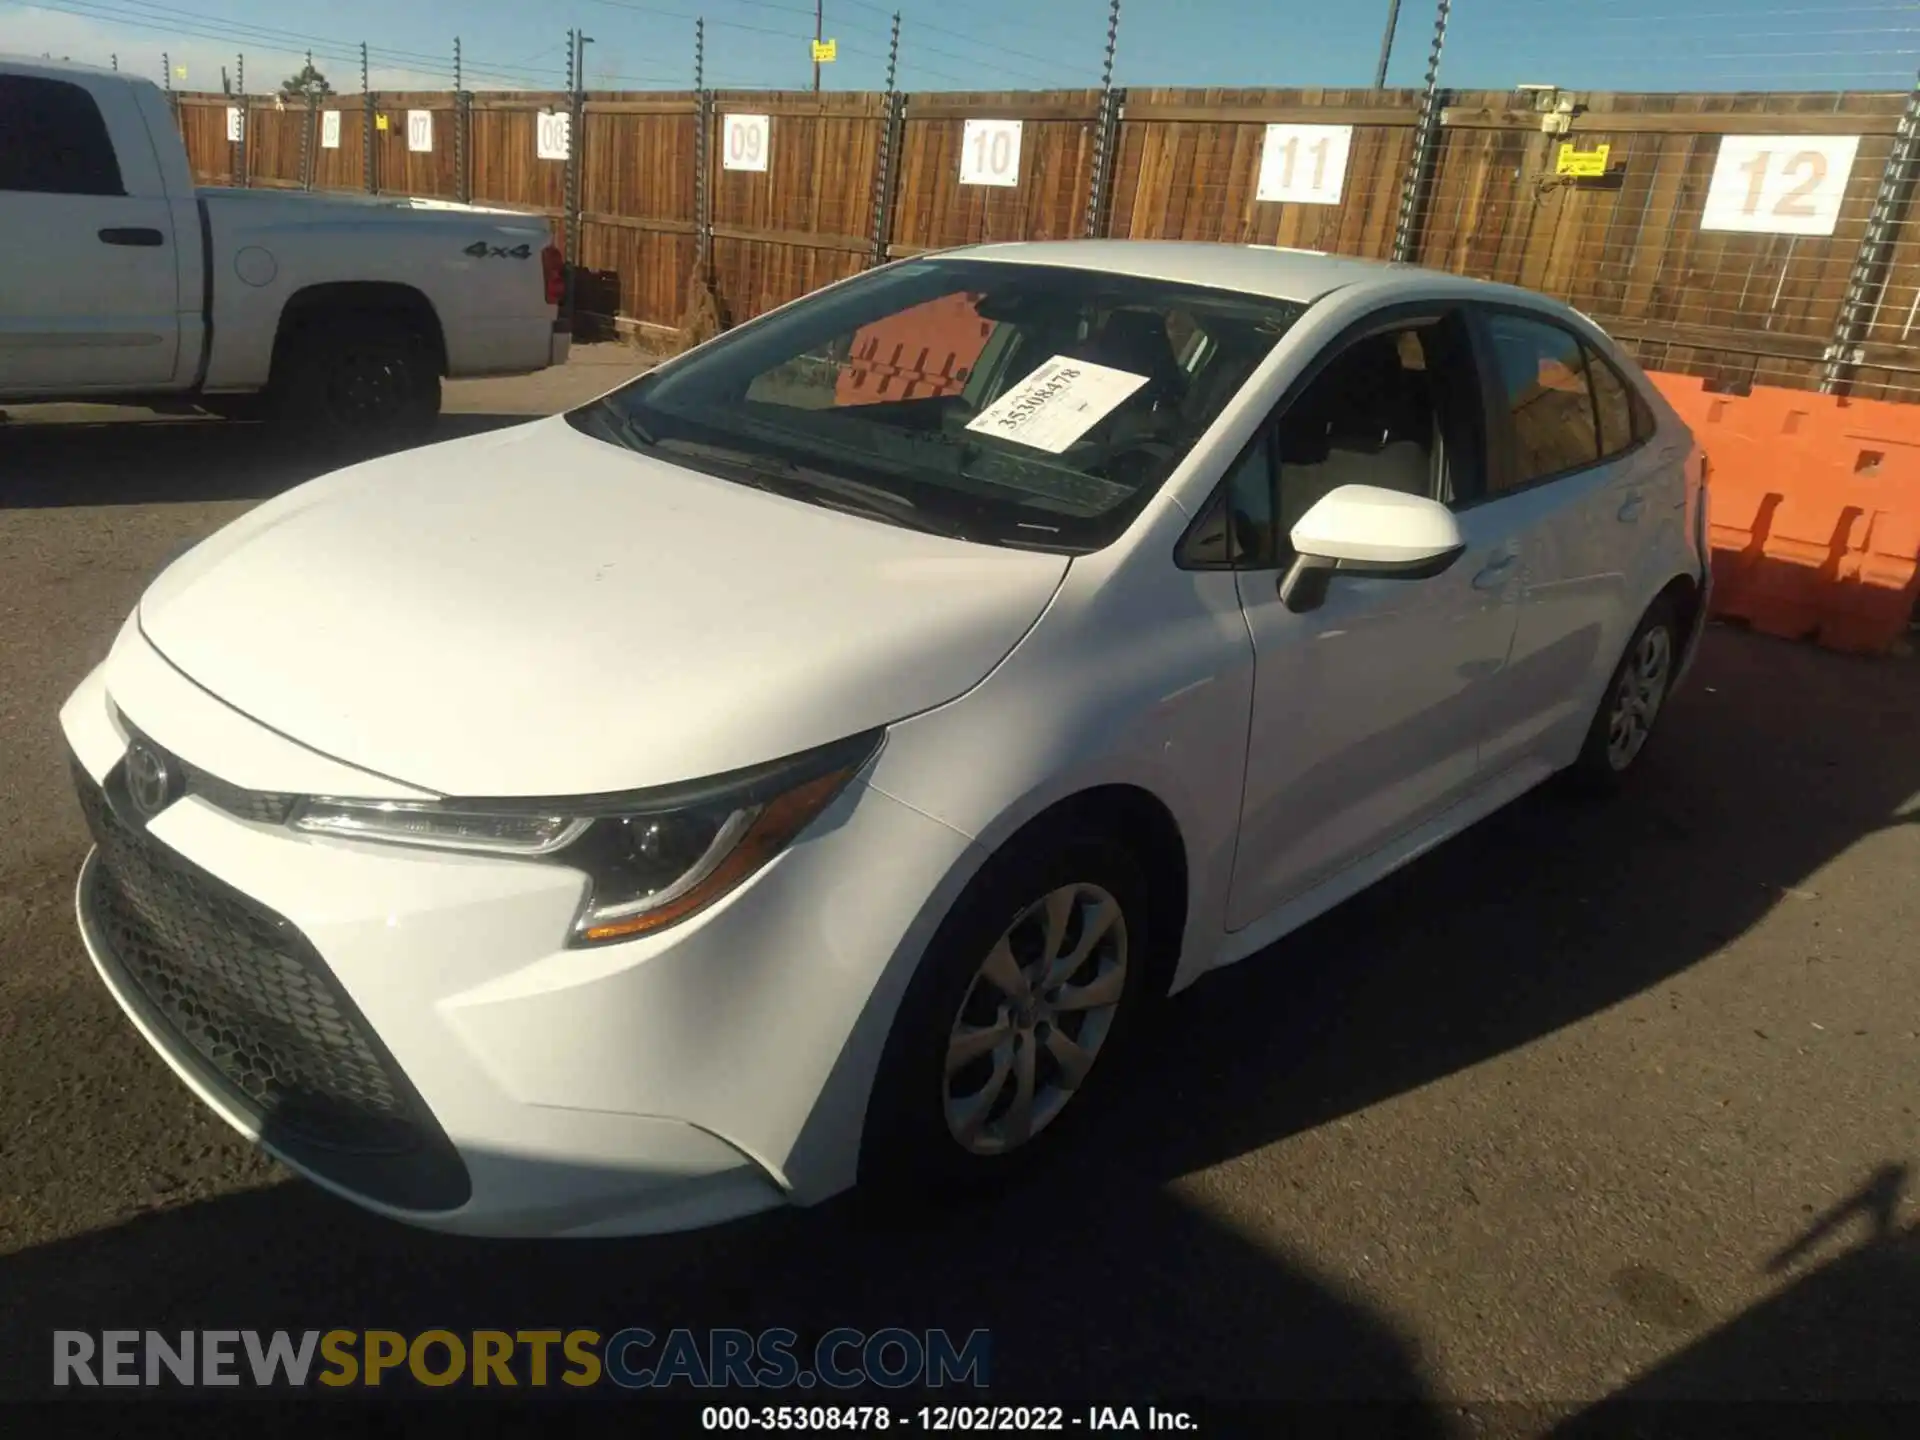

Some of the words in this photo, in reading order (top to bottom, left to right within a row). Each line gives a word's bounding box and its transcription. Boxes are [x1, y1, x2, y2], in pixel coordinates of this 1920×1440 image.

[411, 115, 428, 144] 07
[543, 120, 563, 150] 08
[731, 123, 761, 162] 09
[973, 129, 1011, 176] 10
[1278, 136, 1329, 190] 11
[1738, 150, 1828, 217] 12
[463, 241, 532, 260] 4x4
[998, 368, 1081, 430] 35308478
